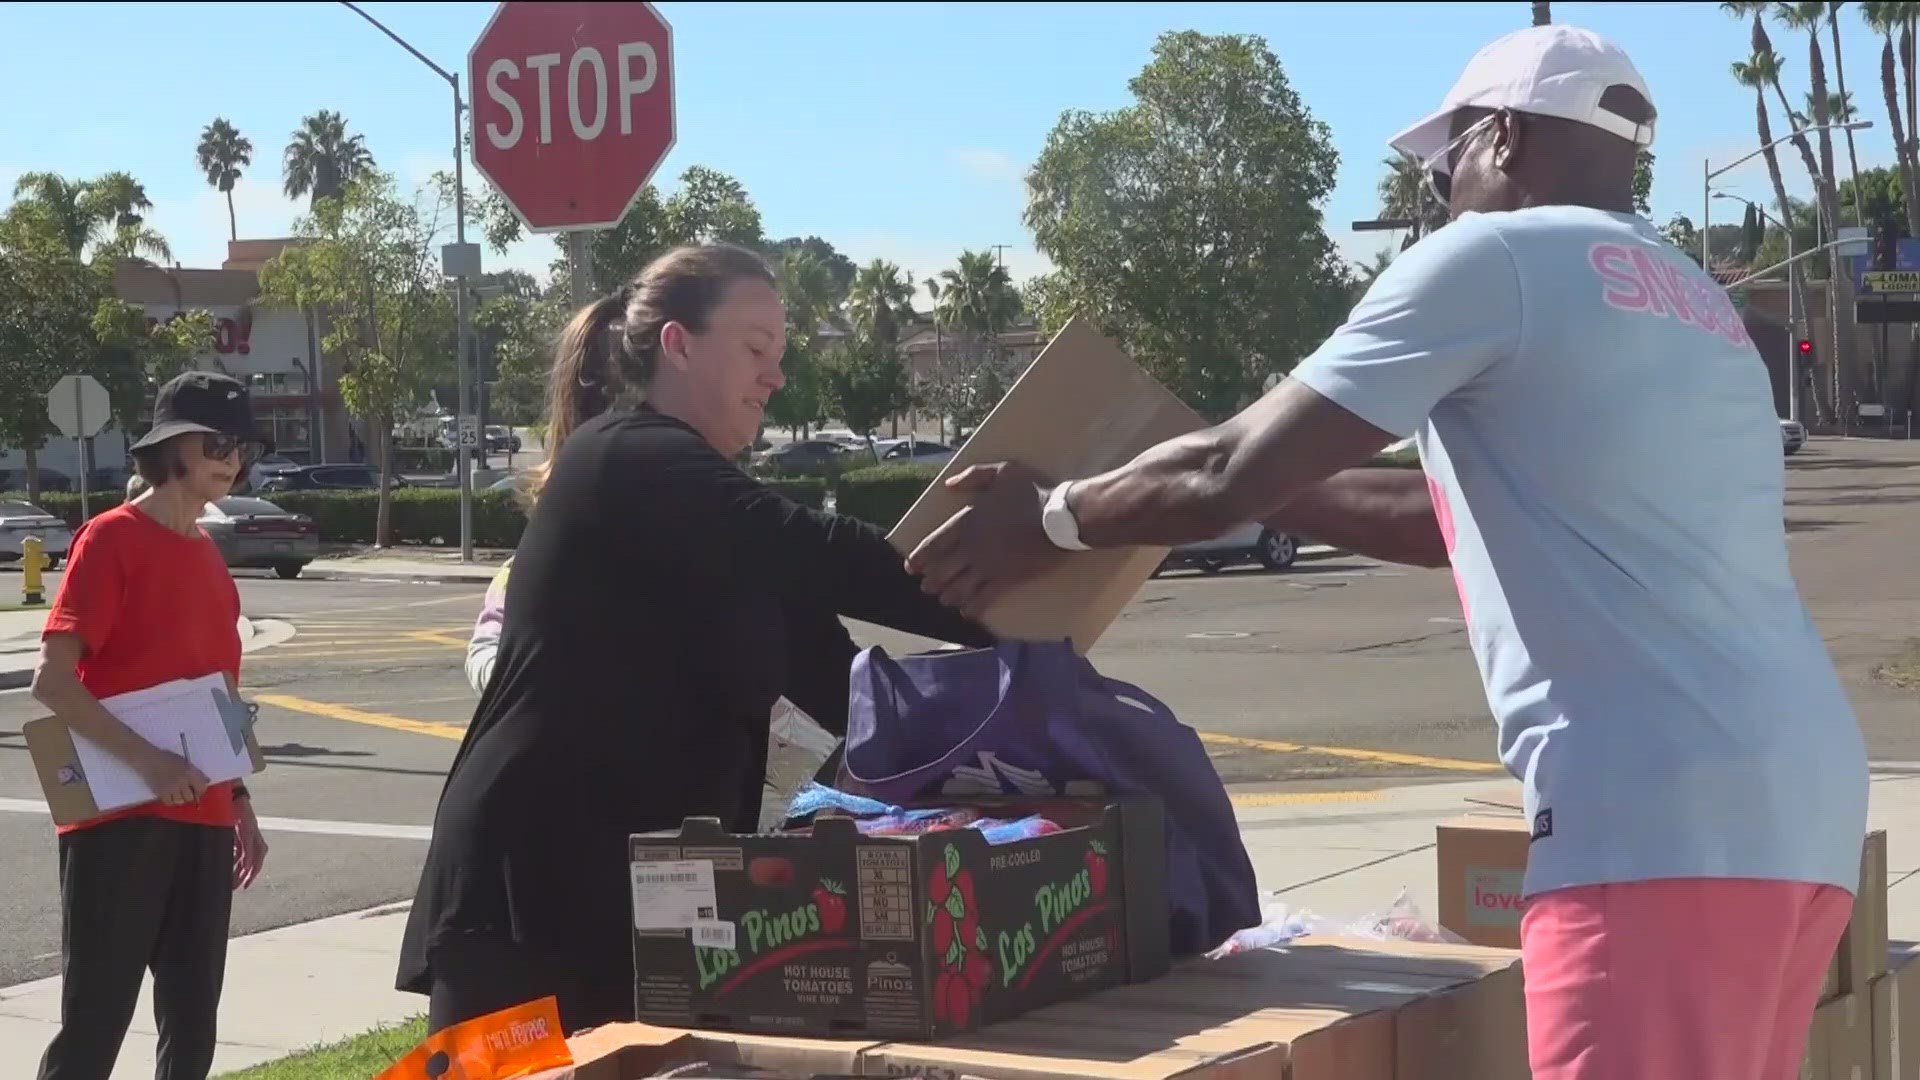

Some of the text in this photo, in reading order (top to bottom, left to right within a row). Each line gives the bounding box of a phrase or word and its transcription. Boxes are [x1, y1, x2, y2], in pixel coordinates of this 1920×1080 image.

[486, 41, 657, 150] STOP
[1881, 273, 1918, 282] LOMA
[461, 431, 477, 444] 25
[867, 851, 899, 859] ROMA
[990, 849, 1041, 870] PRE-COOLED
[742, 903, 820, 953] Pinos
[999, 921, 1036, 988] Los
[1036, 869, 1091, 934] Pinos
[784, 964, 850, 979] HOT HOUSE
[783, 979, 854, 994] TOMATOES
[867, 976, 913, 991] Pinos
